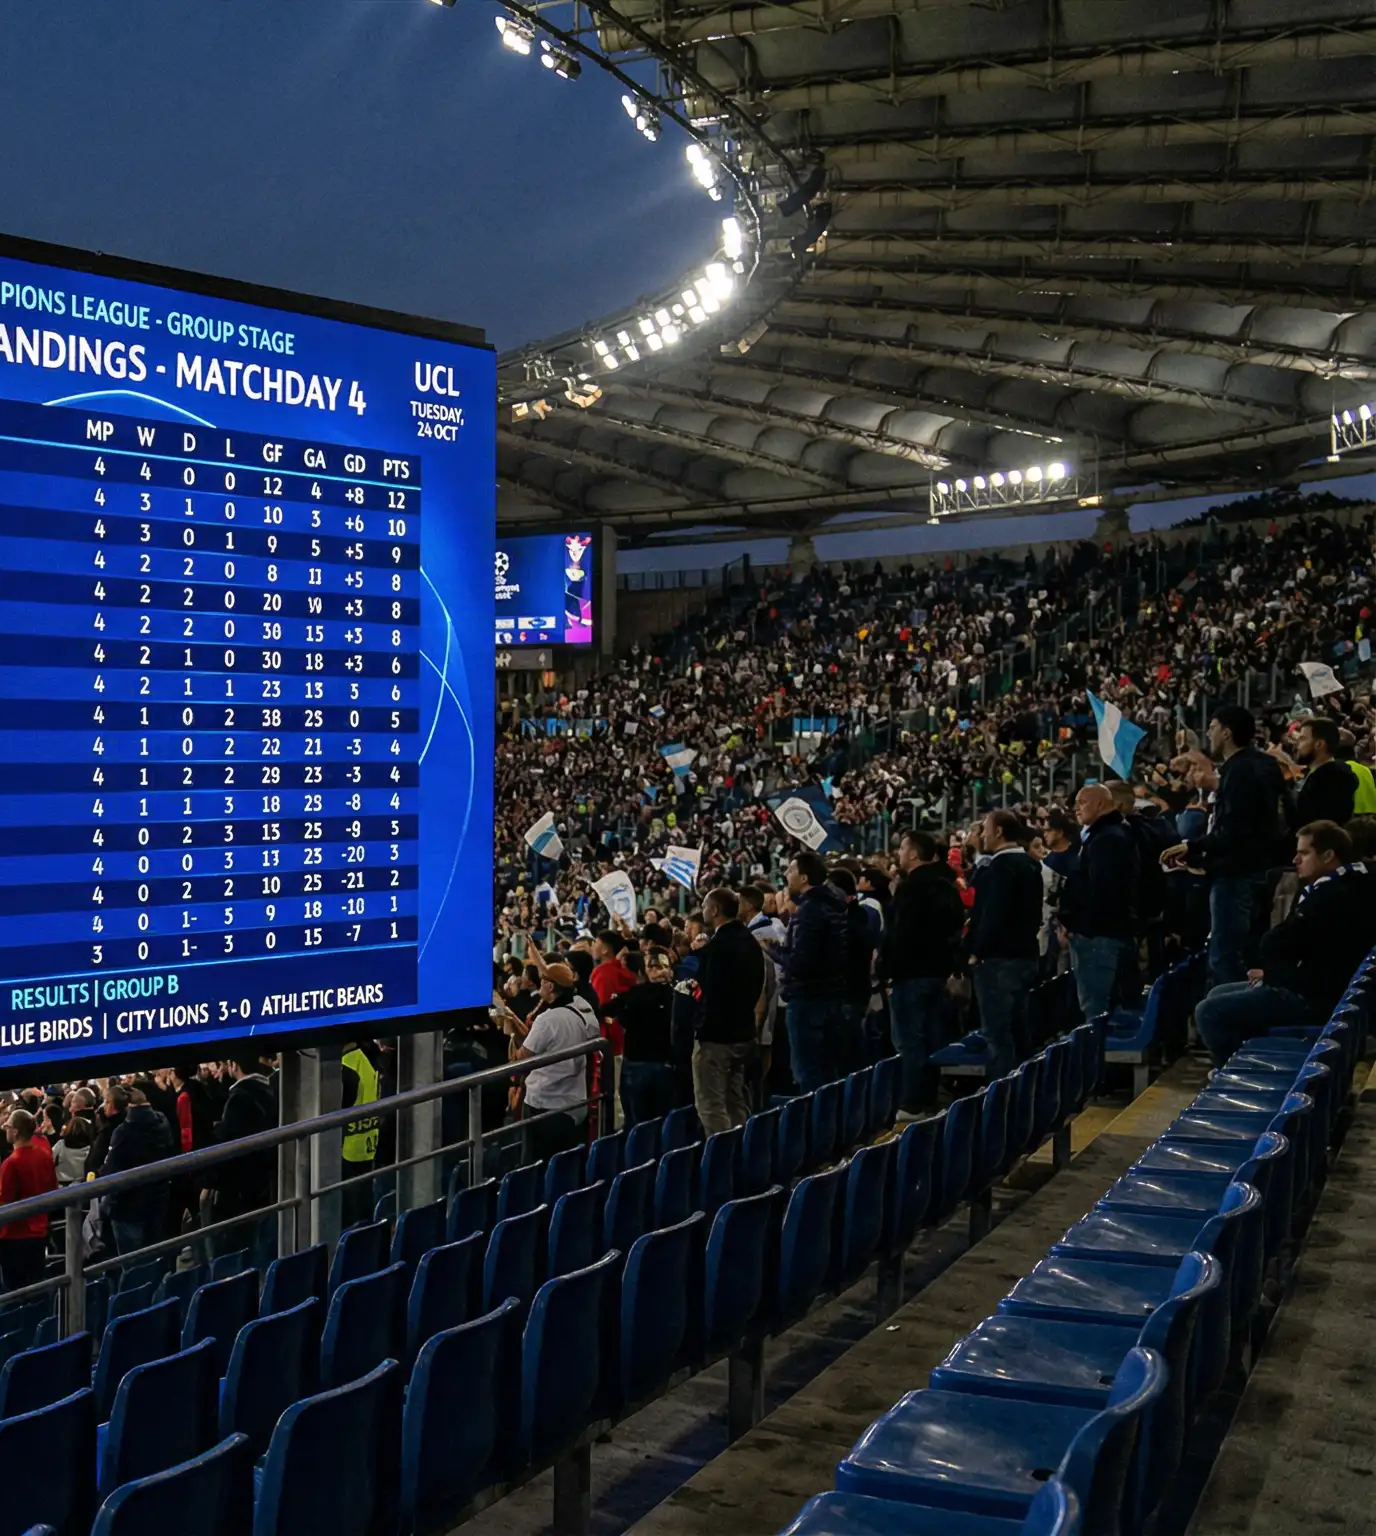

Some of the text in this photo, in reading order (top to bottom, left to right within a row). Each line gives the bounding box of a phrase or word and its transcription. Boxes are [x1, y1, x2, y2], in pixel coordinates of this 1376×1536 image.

[72, 295, 150, 329] LEAGUE
[167, 312, 234, 343] GROUP
[239, 325, 294, 355] STAGE
[177, 352, 342, 411] MATCHDAY
[348, 381, 366, 415] 4
[415, 362, 460, 396] UCL
[410, 401, 464, 425] TUESDAY,
[416, 420, 459, 442] 24 OCT
[87, 420, 113, 441] MP
[137, 426, 155, 446] W
[184, 433, 195, 451] D
[226, 438, 235, 457] L
[263, 443, 283, 462] GF
[304, 449, 326, 468] GA
[344, 454, 365, 473] GD
[384, 459, 409, 478] PTS
[95, 457, 105, 475] 4
[140, 462, 151, 480] 4
[184, 468, 195, 485] 0
[225, 472, 235, 490] 0
[264, 477, 282, 495] 12
[311, 482, 321, 499] 4
[345, 487, 364, 504] +8
[389, 492, 405, 509] 12
[95, 488, 105, 506] 4
[141, 493, 150, 510] 3
[185, 499, 193, 515] 1
[225, 502, 235, 519] 0
[264, 506, 282, 524] 10
[312, 510, 321, 527] 3
[345, 515, 364, 532] +6
[388, 519, 406, 536] 10
[95, 520, 105, 538] 4
[141, 524, 150, 541] 3
[184, 528, 194, 545] 0
[226, 532, 234, 549] 1
[268, 536, 277, 552] 9
[312, 540, 320, 556] 5
[346, 543, 363, 559] +5
[392, 547, 400, 563] 9
[345, 571, 363, 588] +5
[264, 594, 281, 611] 20
[345, 600, 362, 616] +3
[306, 626, 323, 642] 15
[263, 652, 281, 668] 30
[306, 653, 323, 670] 18
[345, 655, 362, 671] +3
[262, 680, 280, 697] 23
[263, 709, 281, 726] 38
[305, 738, 322, 755] 21
[347, 739, 361, 755] -3
[305, 767, 322, 783] 23
[263, 796, 280, 812] 18
[346, 794, 361, 810] -8
[346, 821, 360, 837] -9
[342, 846, 364, 862] -20
[263, 877, 280, 894] 10
[304, 874, 321, 891] 25
[342, 872, 364, 888] -21
[304, 901, 322, 918] 18
[342, 898, 364, 915] -10
[305, 928, 322, 945] 15
[347, 925, 360, 941] -7
[12, 983, 89, 1010] RESULTS
[104, 976, 163, 1000] GROUP
[168, 975, 178, 994] B
[40, 1016, 92, 1042] BIRDS
[117, 1009, 156, 1033] CITY
[160, 1003, 209, 1028] LIONS
[261, 989, 334, 1015] ATHLETIC
[338, 984, 383, 1006] BEARS
